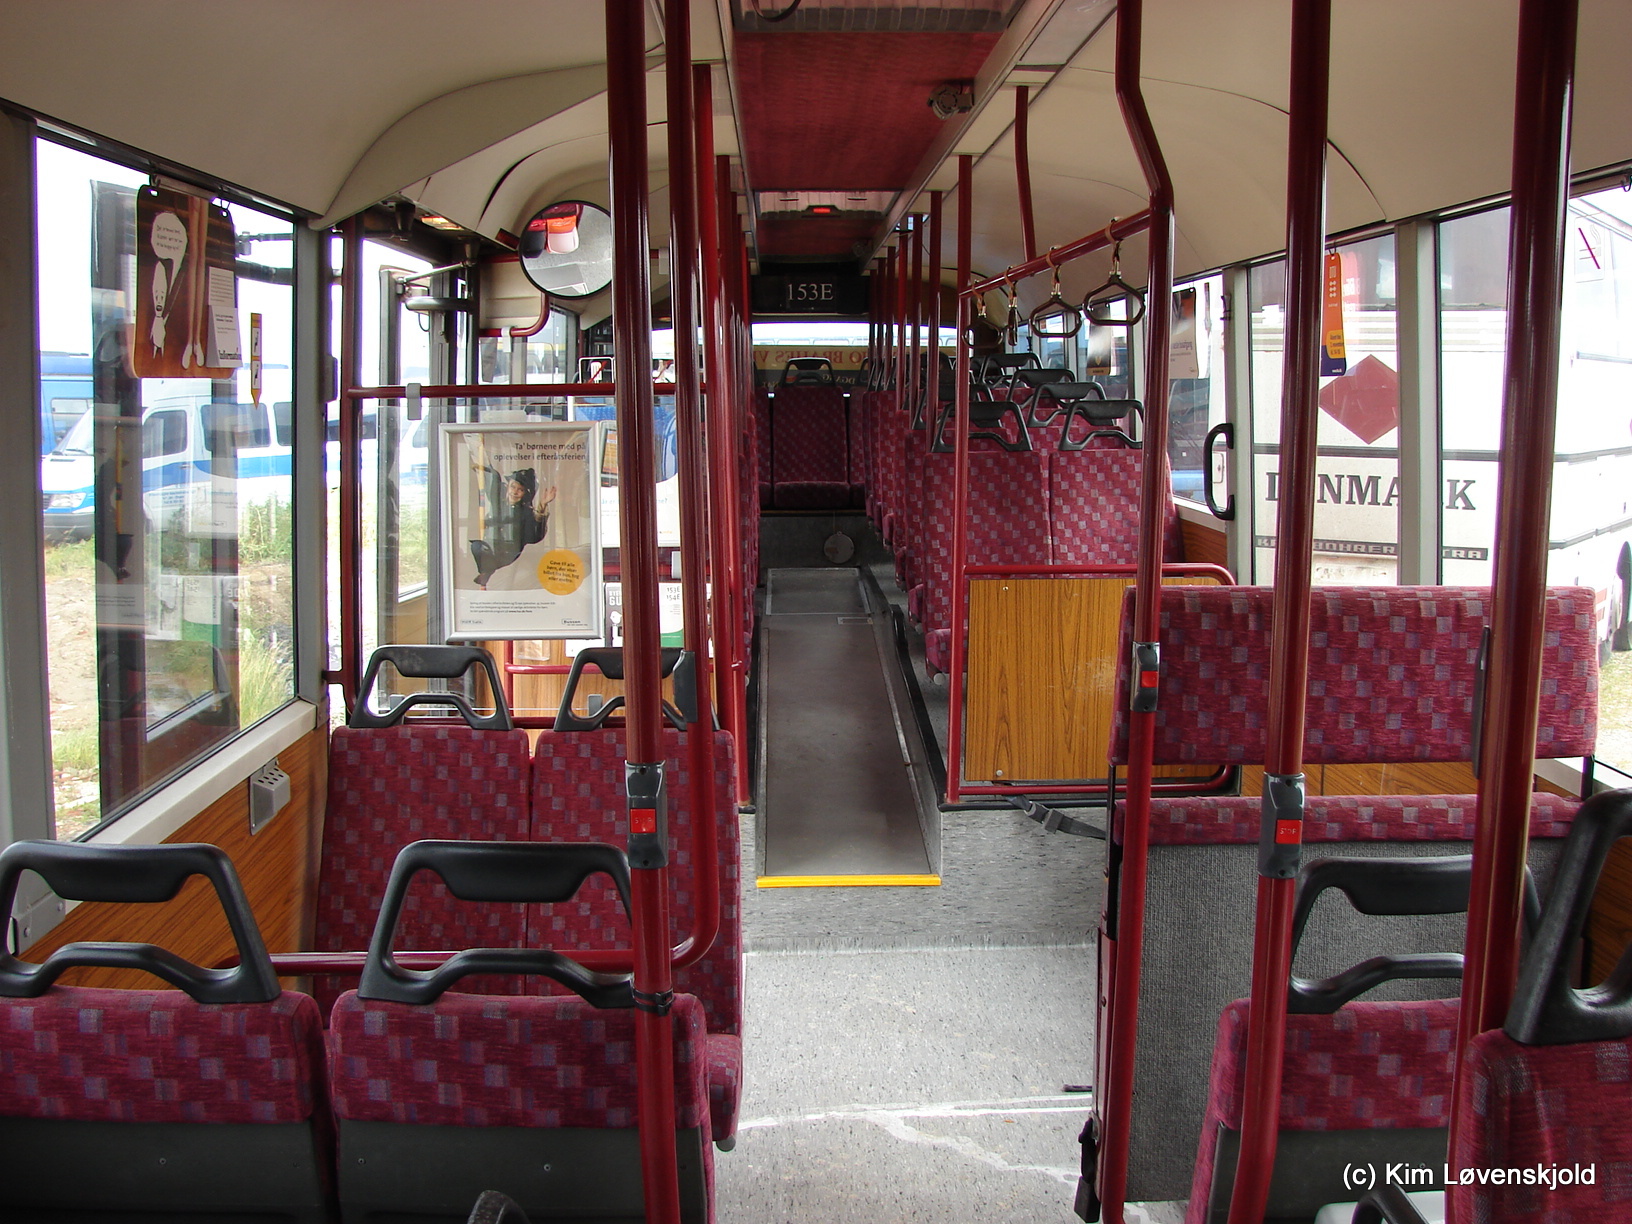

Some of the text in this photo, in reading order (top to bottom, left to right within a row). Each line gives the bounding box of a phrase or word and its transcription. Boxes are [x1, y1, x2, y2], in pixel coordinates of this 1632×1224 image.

[787, 283, 834, 302] 153E
[494, 453, 530, 462] oplevelser
[1264, 472, 1476, 510] NMAK
[666, 585, 681, 594] 153E
